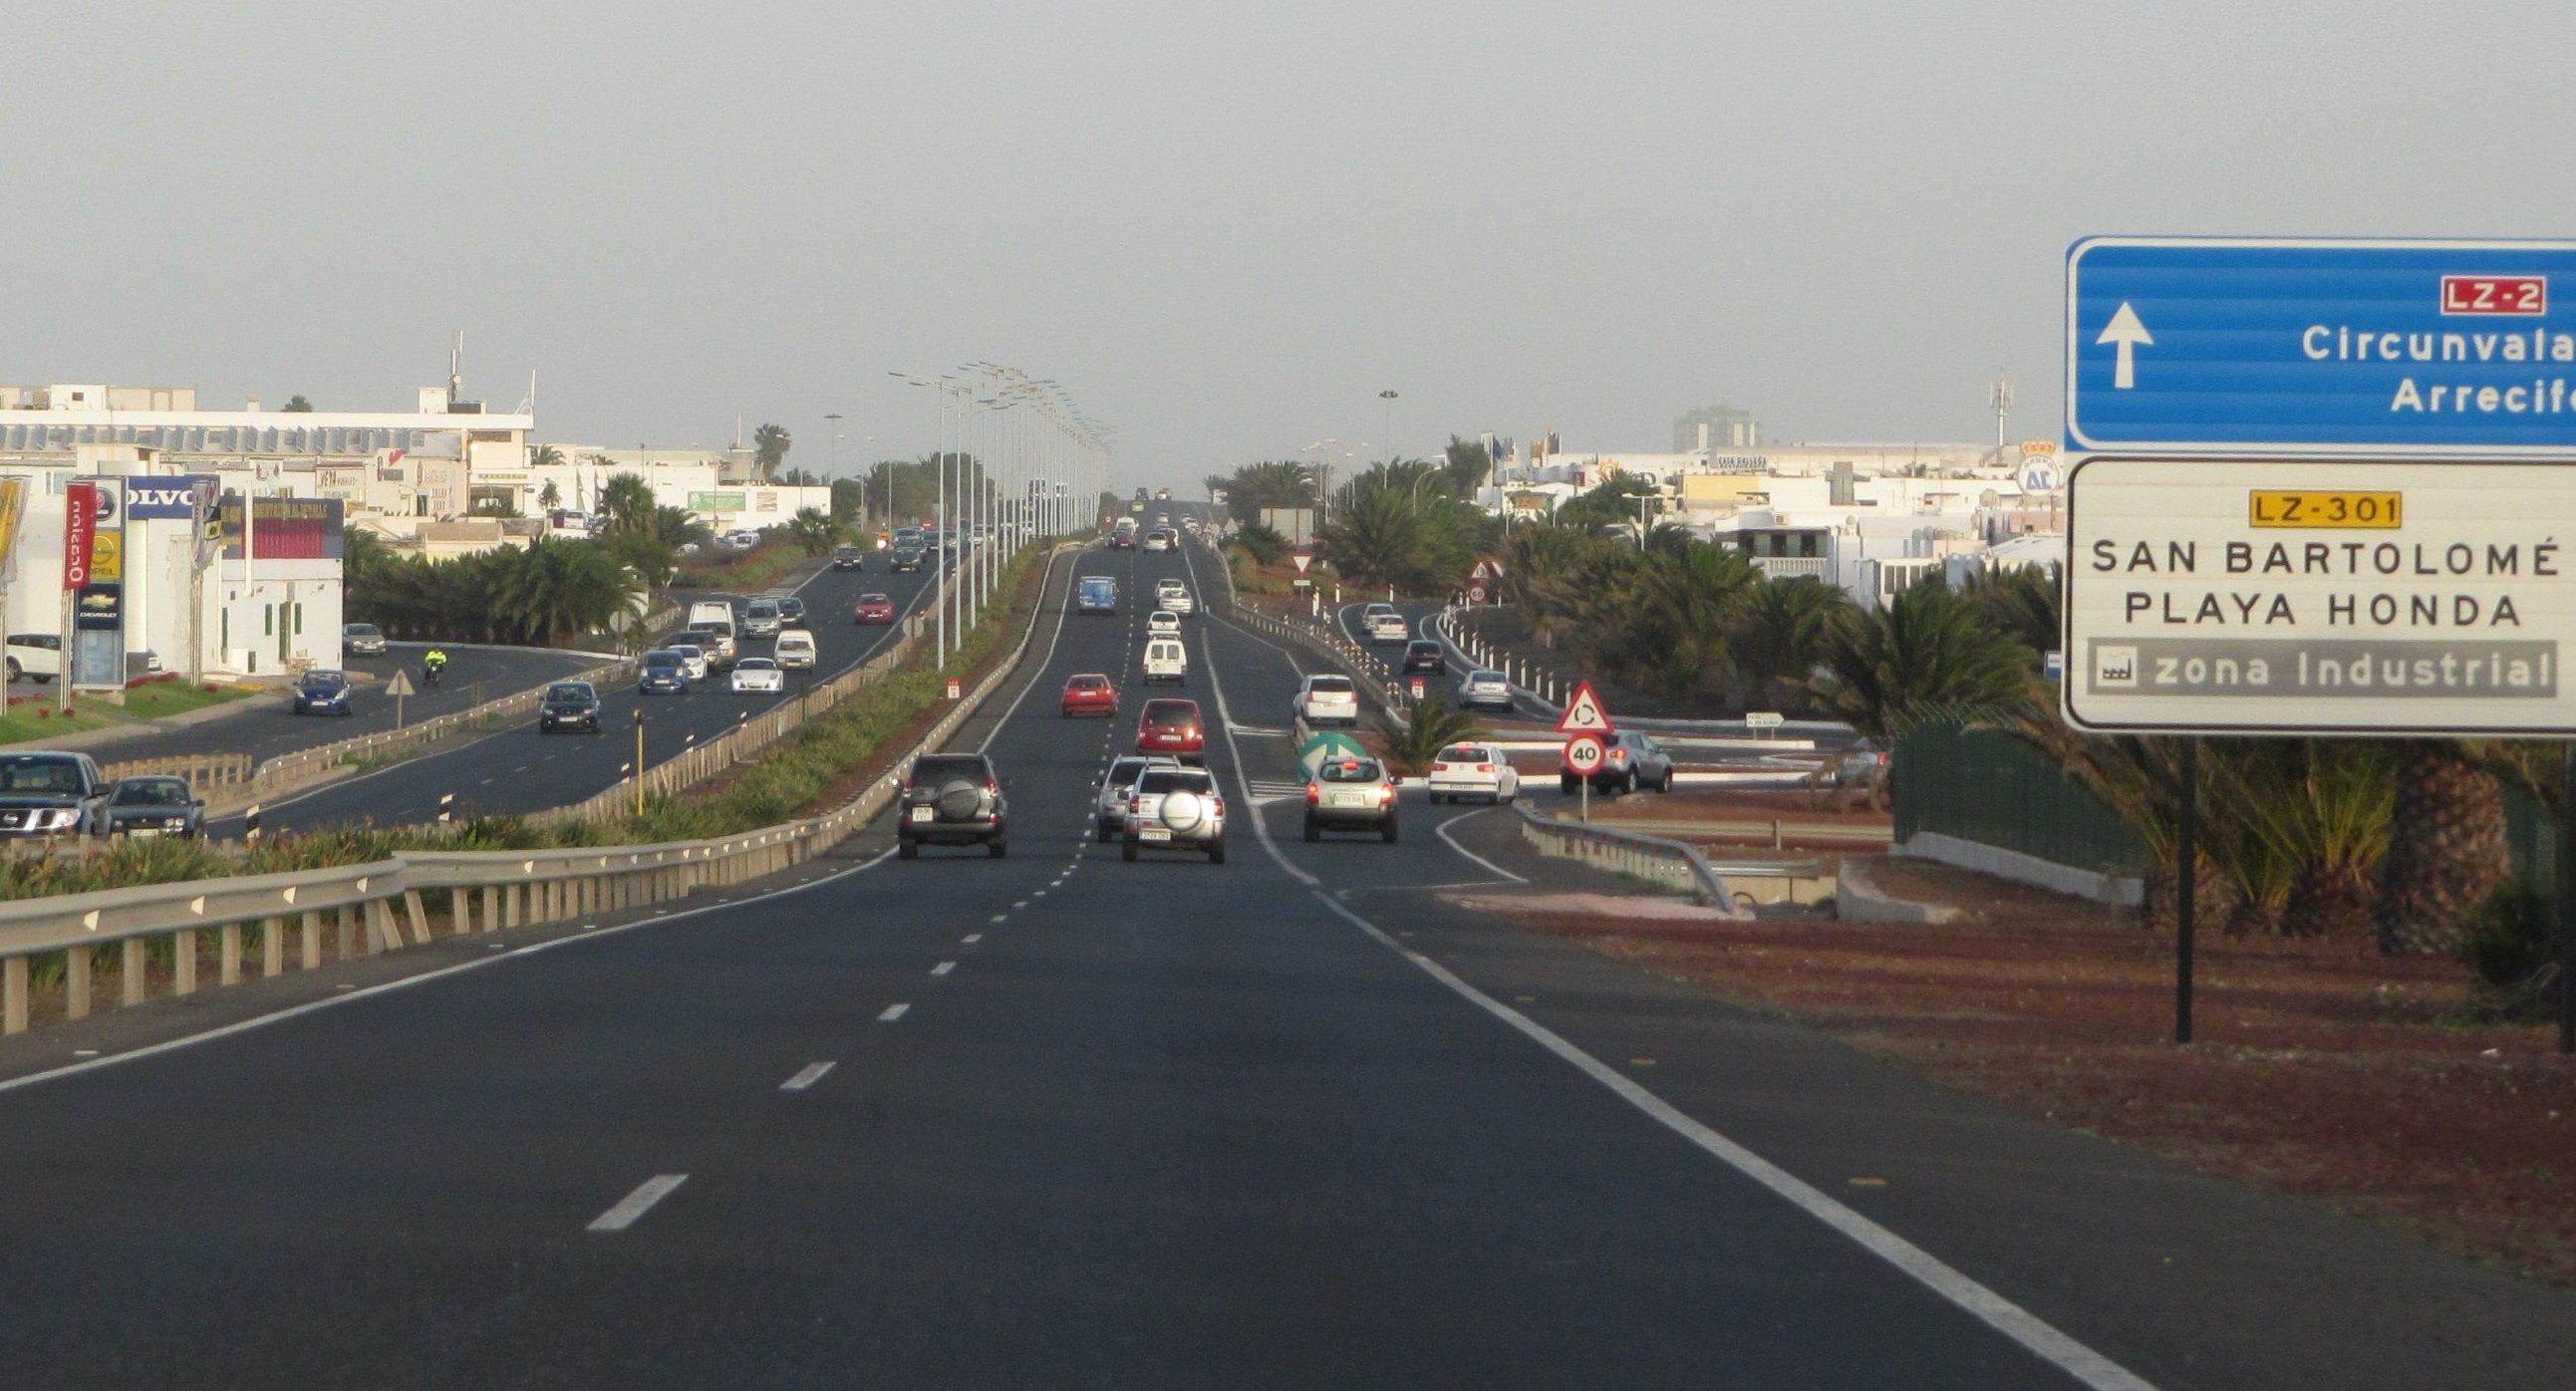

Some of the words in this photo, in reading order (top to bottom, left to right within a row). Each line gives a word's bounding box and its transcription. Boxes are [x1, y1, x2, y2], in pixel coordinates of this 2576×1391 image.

[2446, 282, 2540, 310] LZ-2
[2302, 325, 2575, 362] Circunvala
[2391, 378, 2576, 414] Arrecif
[2255, 497, 2397, 522] LZ-301
[2092, 539, 2195, 573] SAN
[2225, 536, 2559, 576] BARTOLOMÉ
[2126, 591, 2296, 625] PLAYA
[2328, 593, 2521, 627] HONDA
[2154, 658, 2270, 687] zona
[2298, 651, 2551, 688] Industrial
[1573, 746, 1596, 761] 40
